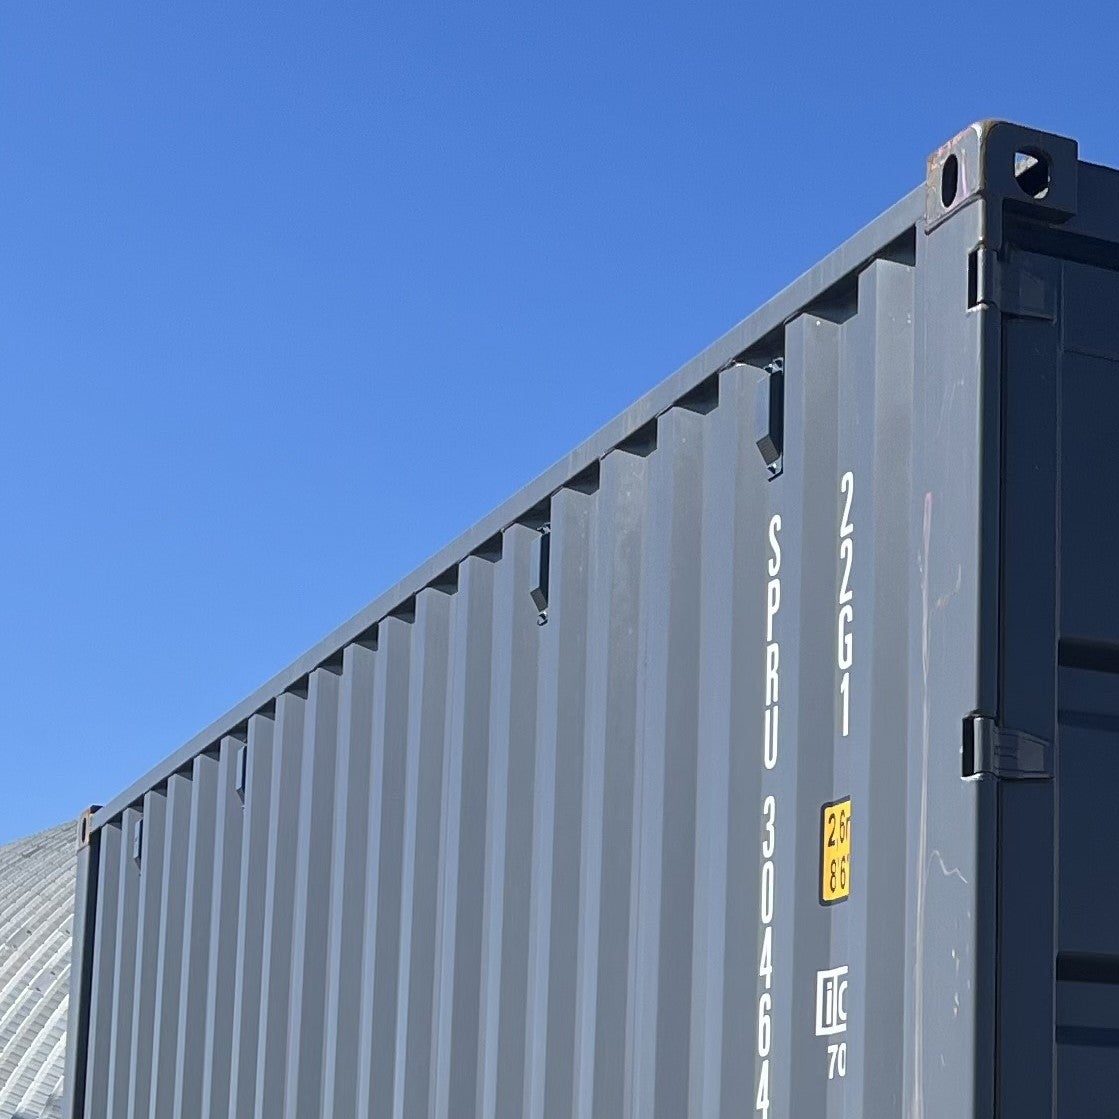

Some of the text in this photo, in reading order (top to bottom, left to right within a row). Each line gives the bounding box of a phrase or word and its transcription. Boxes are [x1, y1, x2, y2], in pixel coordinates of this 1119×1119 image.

[763, 514, 782, 770] SPRU
[838, 471, 854, 737] 22G1
[827, 1043, 847, 1080] 70
